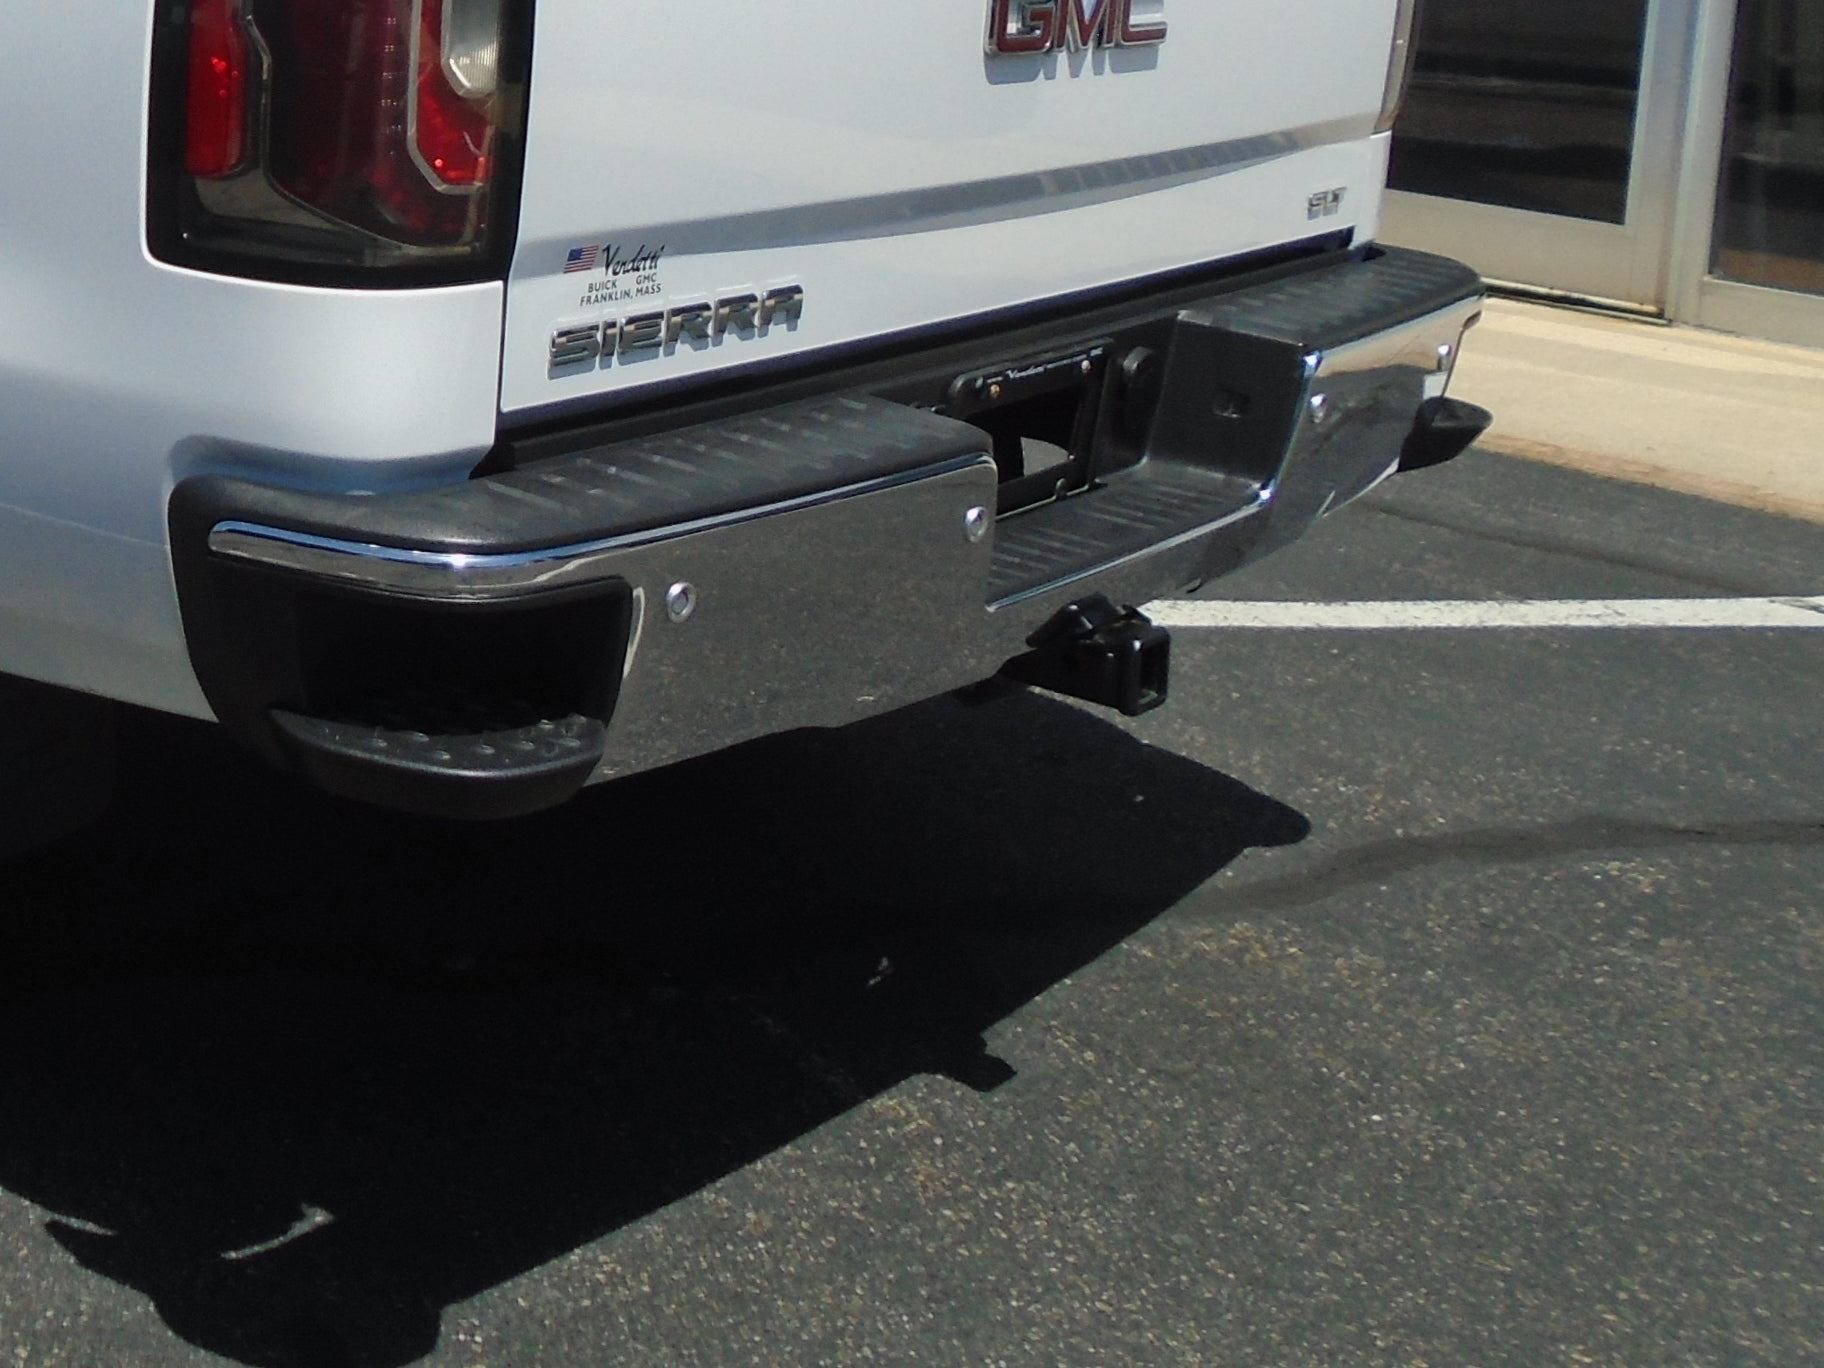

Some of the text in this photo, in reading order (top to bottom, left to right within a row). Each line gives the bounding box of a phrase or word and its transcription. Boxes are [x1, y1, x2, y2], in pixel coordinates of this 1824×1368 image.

[602, 243, 666, 276] Vendetti
[579, 283, 662, 307] FRANKLIN, MASS
[587, 272, 658, 293] BUICK GMC
[547, 284, 804, 369] SIERRA
